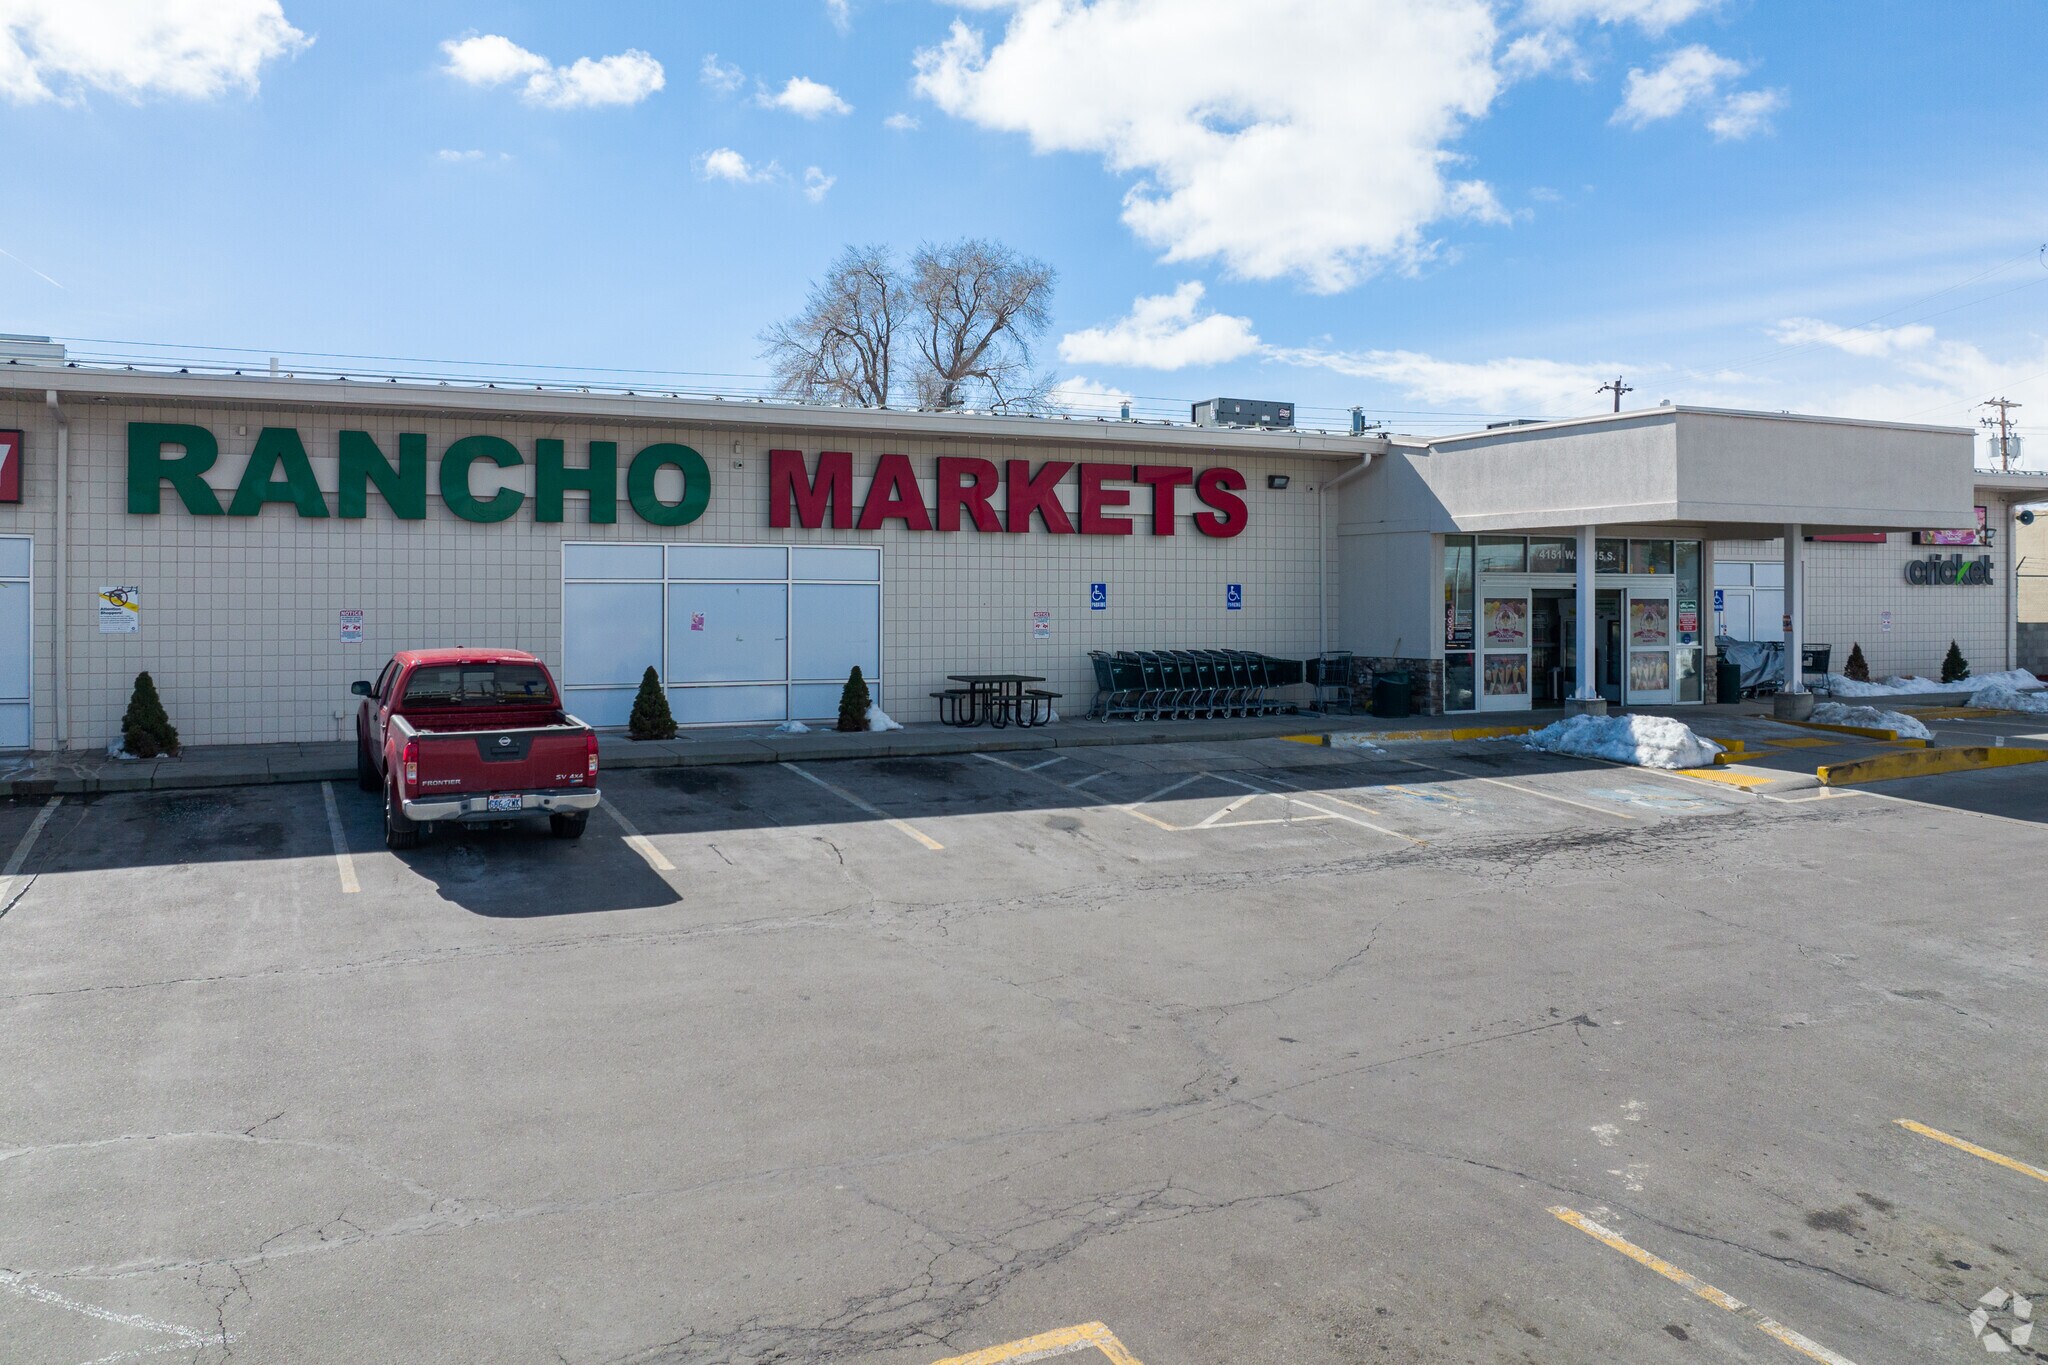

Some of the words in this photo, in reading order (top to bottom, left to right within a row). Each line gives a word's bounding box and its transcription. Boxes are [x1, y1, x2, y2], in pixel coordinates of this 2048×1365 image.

[128, 422, 711, 526] RANCHO
[769, 448, 1248, 538] MARKETS
[1539, 549, 1562, 559] 4151
[1905, 553, 1994, 586] cricket
[422, 779, 461, 787] FRONTIER
